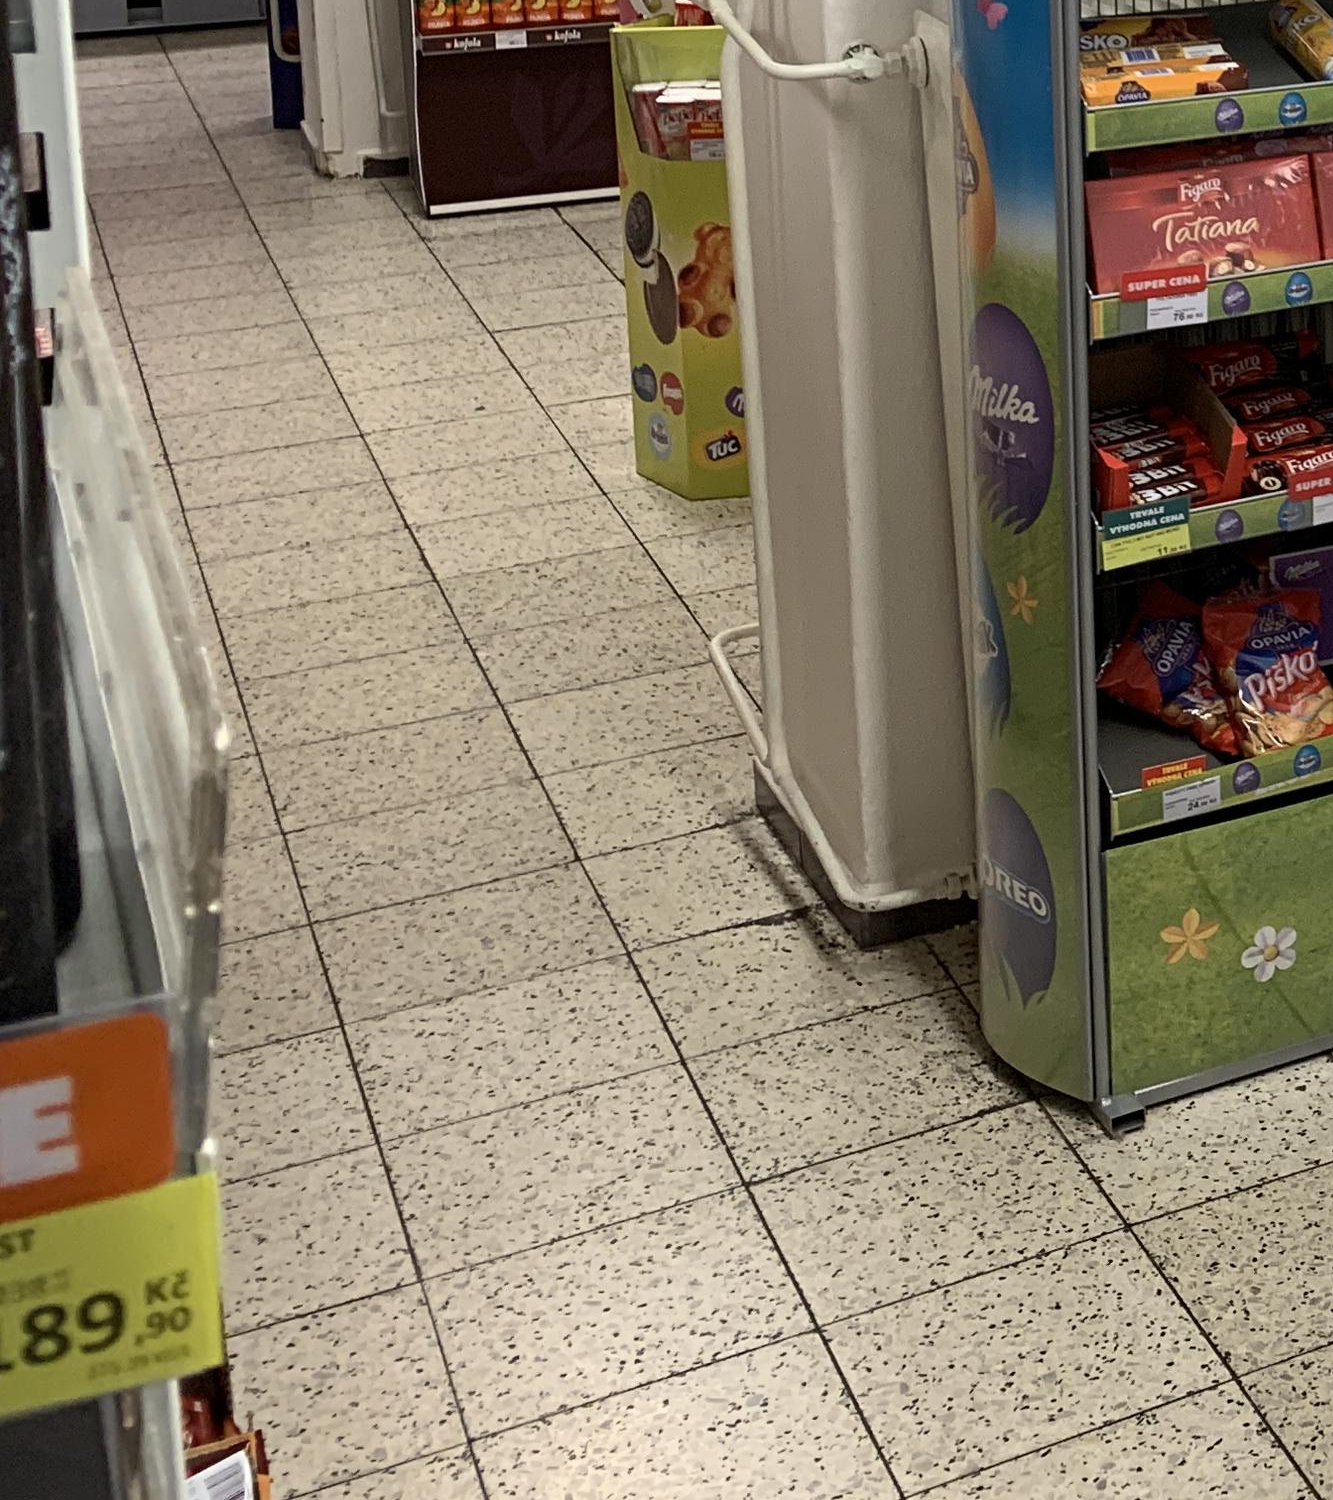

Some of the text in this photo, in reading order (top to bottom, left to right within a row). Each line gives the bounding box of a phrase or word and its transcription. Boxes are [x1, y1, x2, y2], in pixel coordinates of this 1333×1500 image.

[1179, 176, 1222, 203] Figaro
[1151, 212, 1260, 252] Tatiana
[1127, 273, 1201, 292] SUPER CENA
[1208, 352, 1262, 387] Figaro
[1253, 419, 1309, 450] Figaro
[706, 435, 742, 463] TUC
[1295, 475, 1329, 493] SUPER
[1128, 505, 1166, 521] TRVALE
[1159, 510, 1187, 526] CENA
[1157, 619, 1194, 674] OPAVIA
[1249, 623, 1312, 651] OPAVIA
[145, 1271, 191, 1306] Kč
